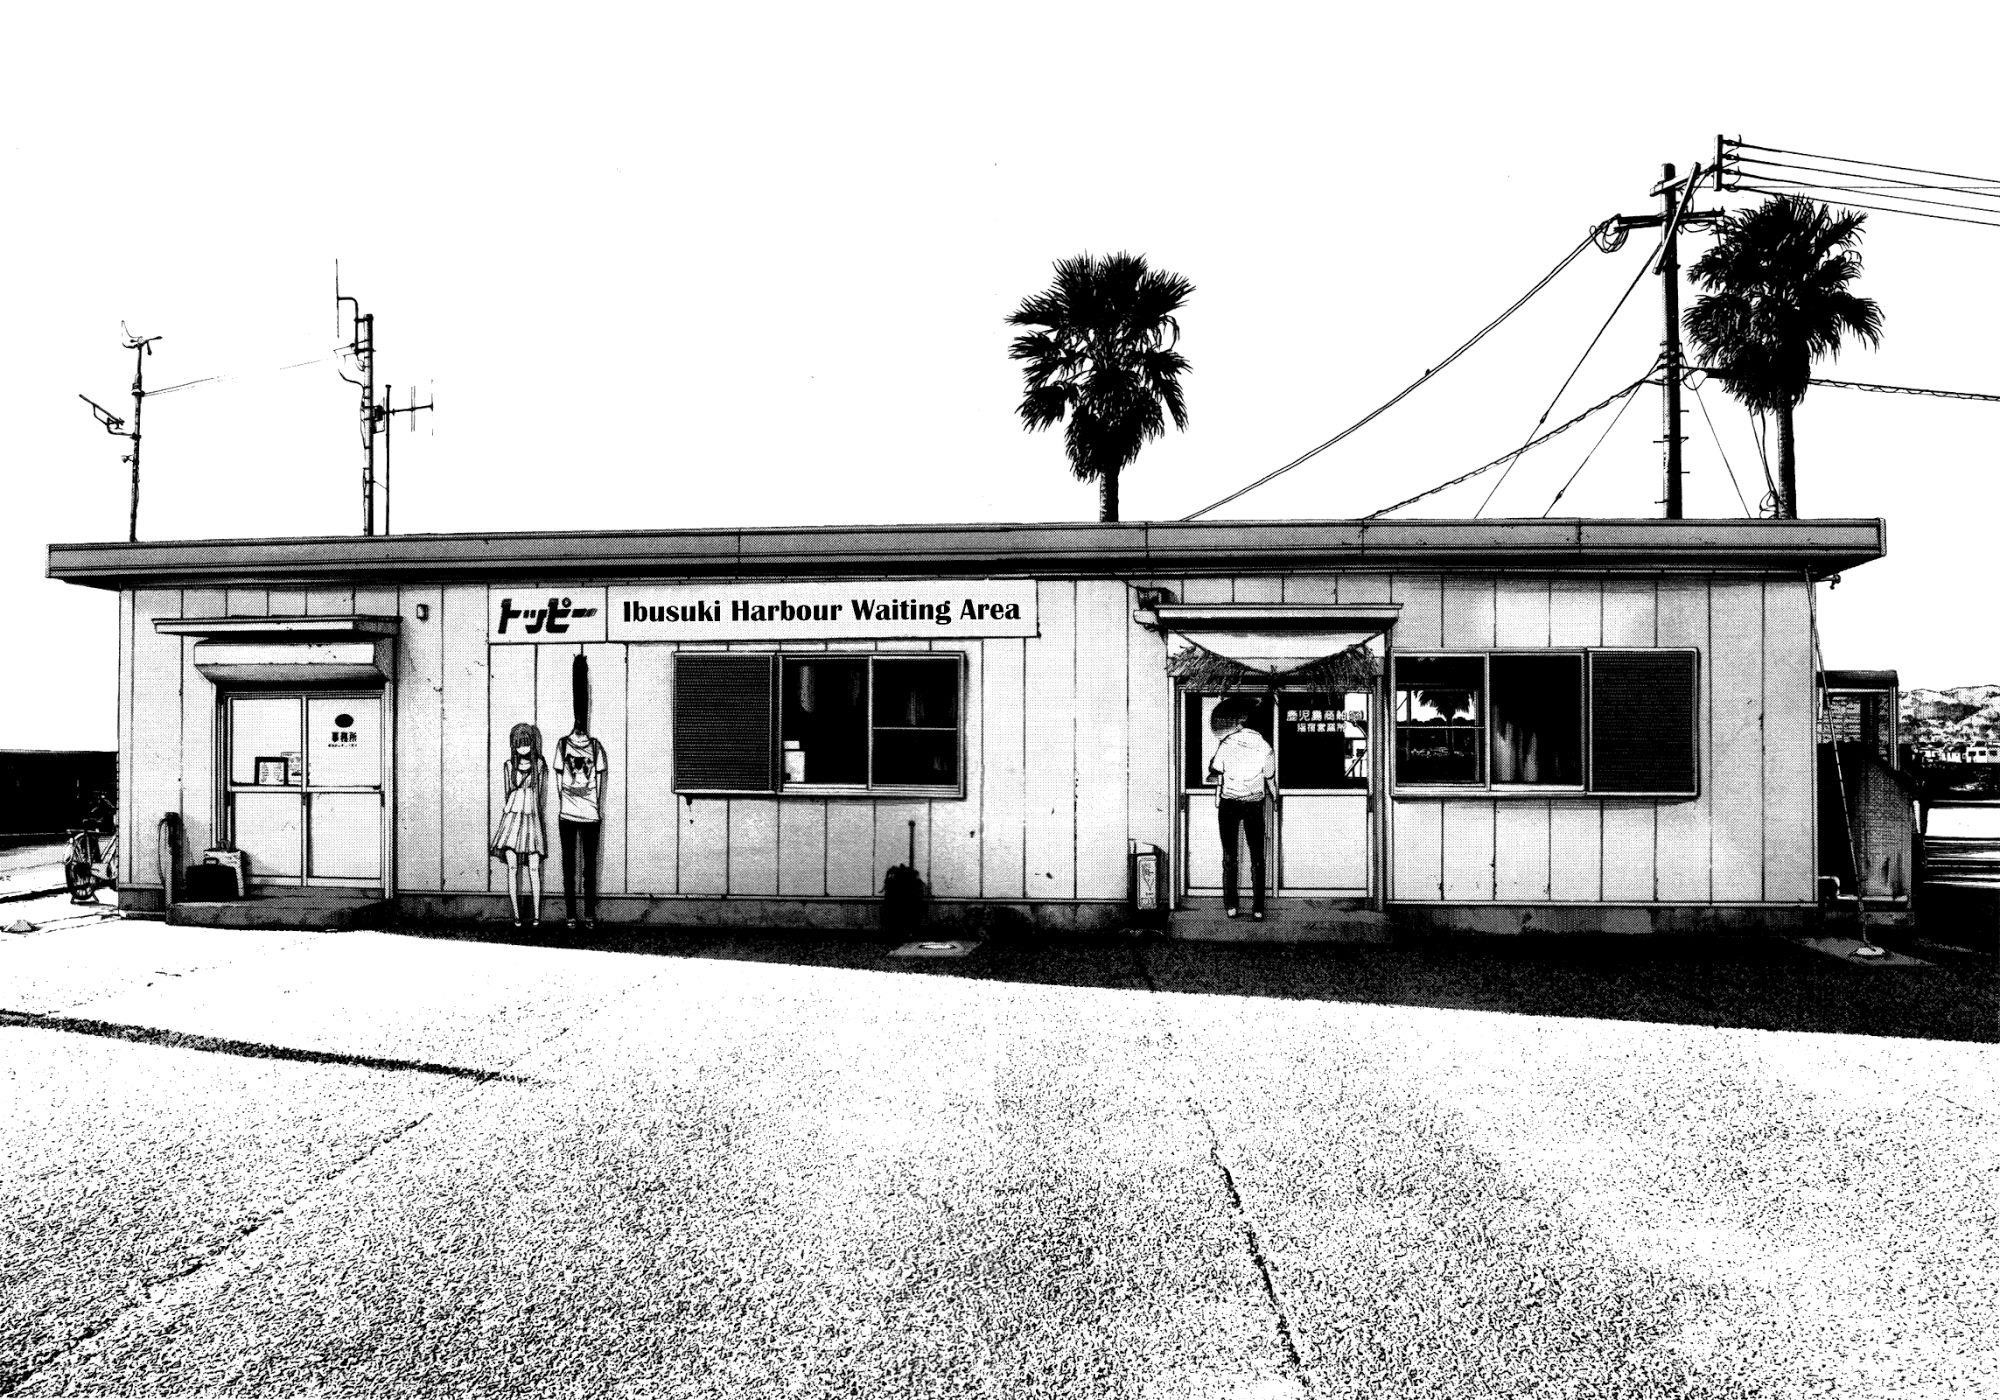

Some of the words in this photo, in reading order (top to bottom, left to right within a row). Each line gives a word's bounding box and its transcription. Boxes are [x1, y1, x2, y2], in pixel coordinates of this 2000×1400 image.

[497, 597, 598, 635] トッピー
[623, 600, 721, 623] Ibusuki
[731, 600, 843, 622] Harbour
[851, 598, 952, 626] Waiting
[960, 598, 1021, 620] Area
